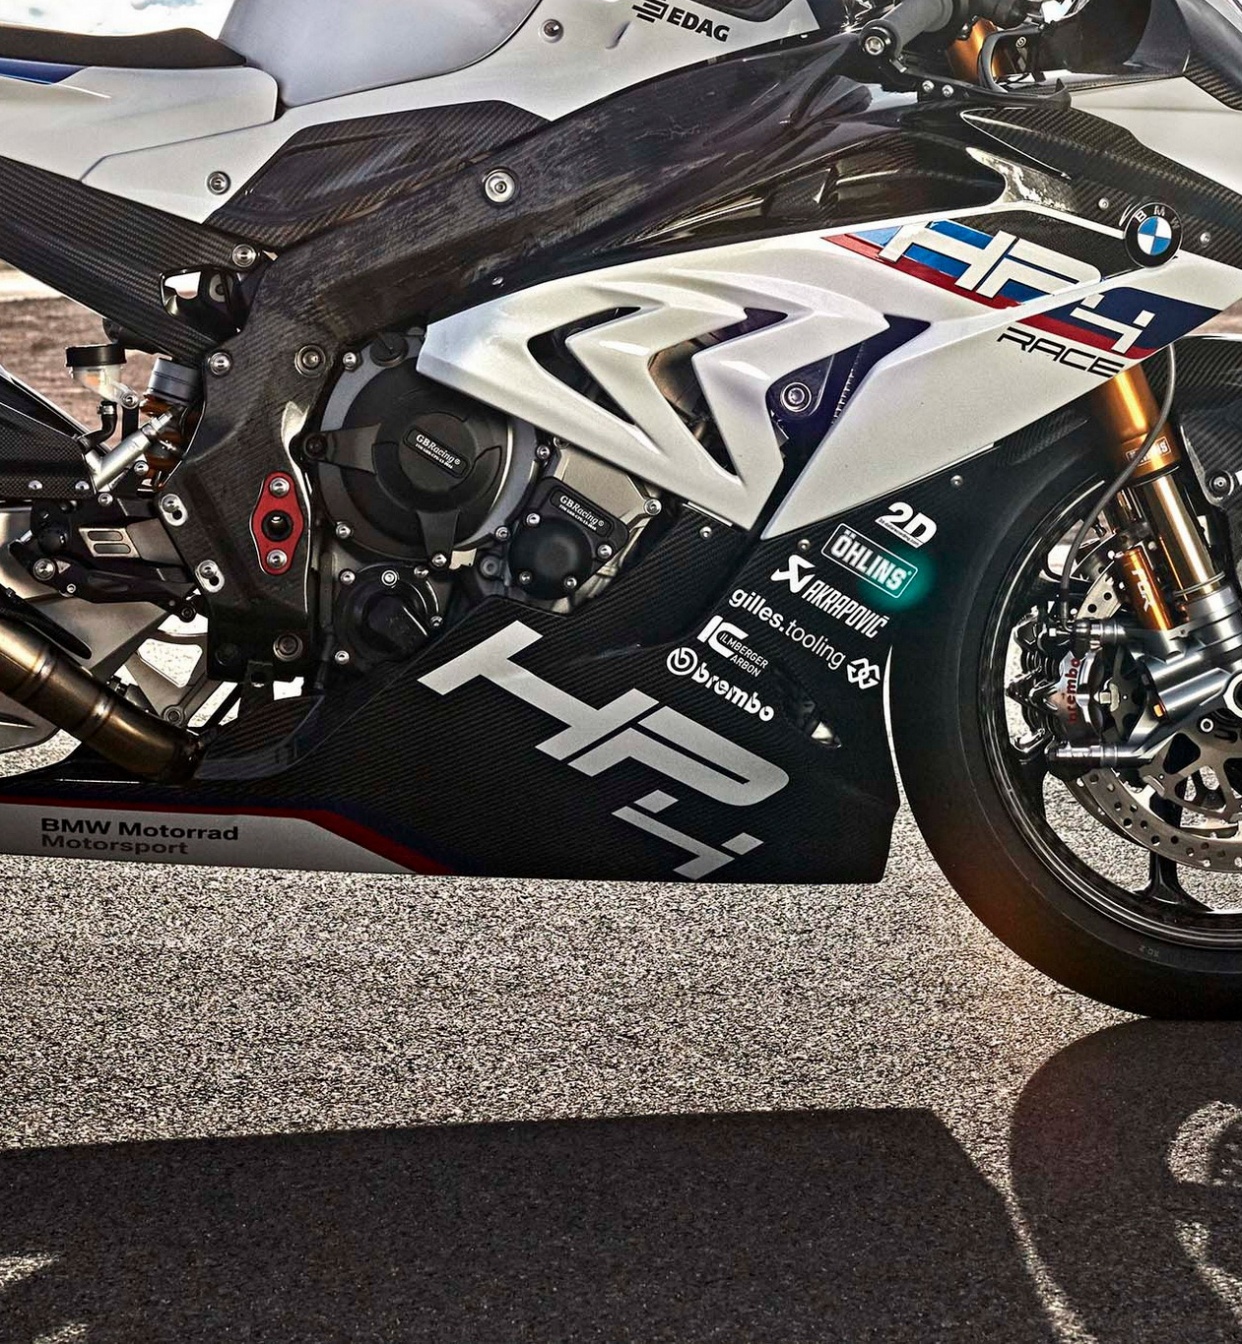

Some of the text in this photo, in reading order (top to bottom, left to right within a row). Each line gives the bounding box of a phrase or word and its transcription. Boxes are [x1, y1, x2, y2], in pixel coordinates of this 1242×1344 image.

[667, 7, 730, 42] EDAG
[1134, 205, 1180, 230] BMW
[996, 326, 1124, 377] RACE
[875, 501, 937, 548] 2D
[831, 529, 908, 591] ÖHLINS
[720, 633, 769, 669] ILMBERGER
[729, 588, 846, 670] gilles.tooling
[691, 662, 775, 722] brembo
[416, 619, 790, 881] HP4
[41, 817, 239, 841] BMW Motorrad
[41, 833, 189, 855] Motorsport
